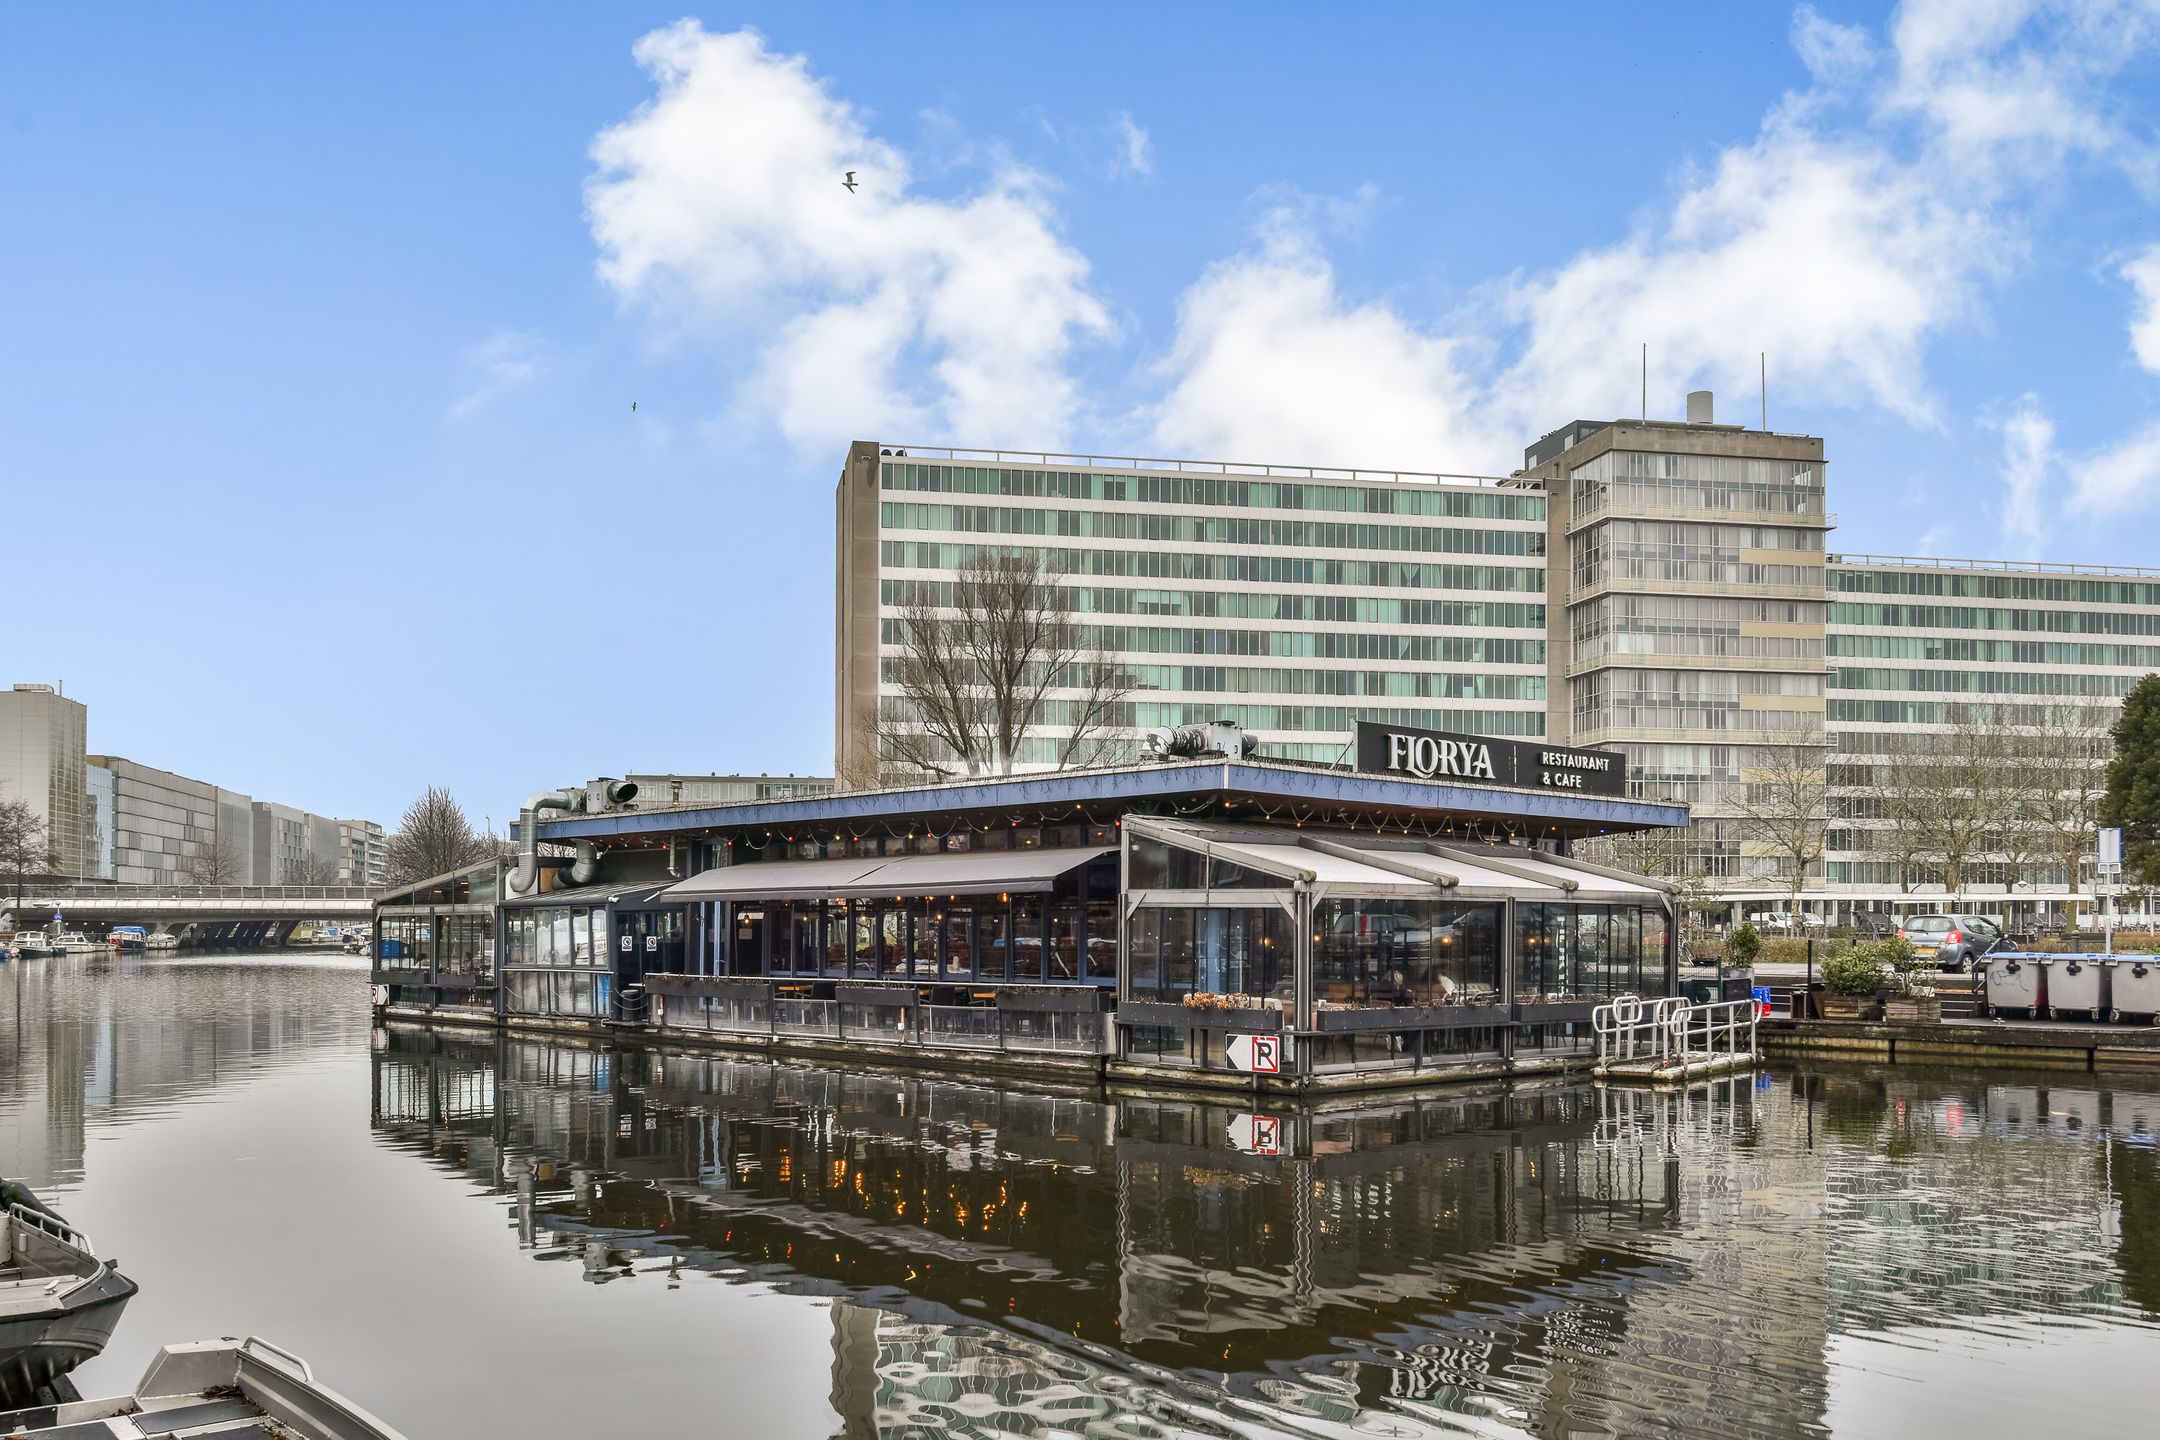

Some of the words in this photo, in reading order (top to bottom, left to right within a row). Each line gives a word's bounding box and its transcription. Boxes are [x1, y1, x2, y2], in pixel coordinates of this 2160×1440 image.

[1387, 734, 1496, 779] FLORYA
[1543, 751, 1610, 771] RESTAURANT
[1543, 772, 1551, 785] &
[1555, 773, 1582, 787] CAFE
[1258, 1043, 1272, 1066] P
